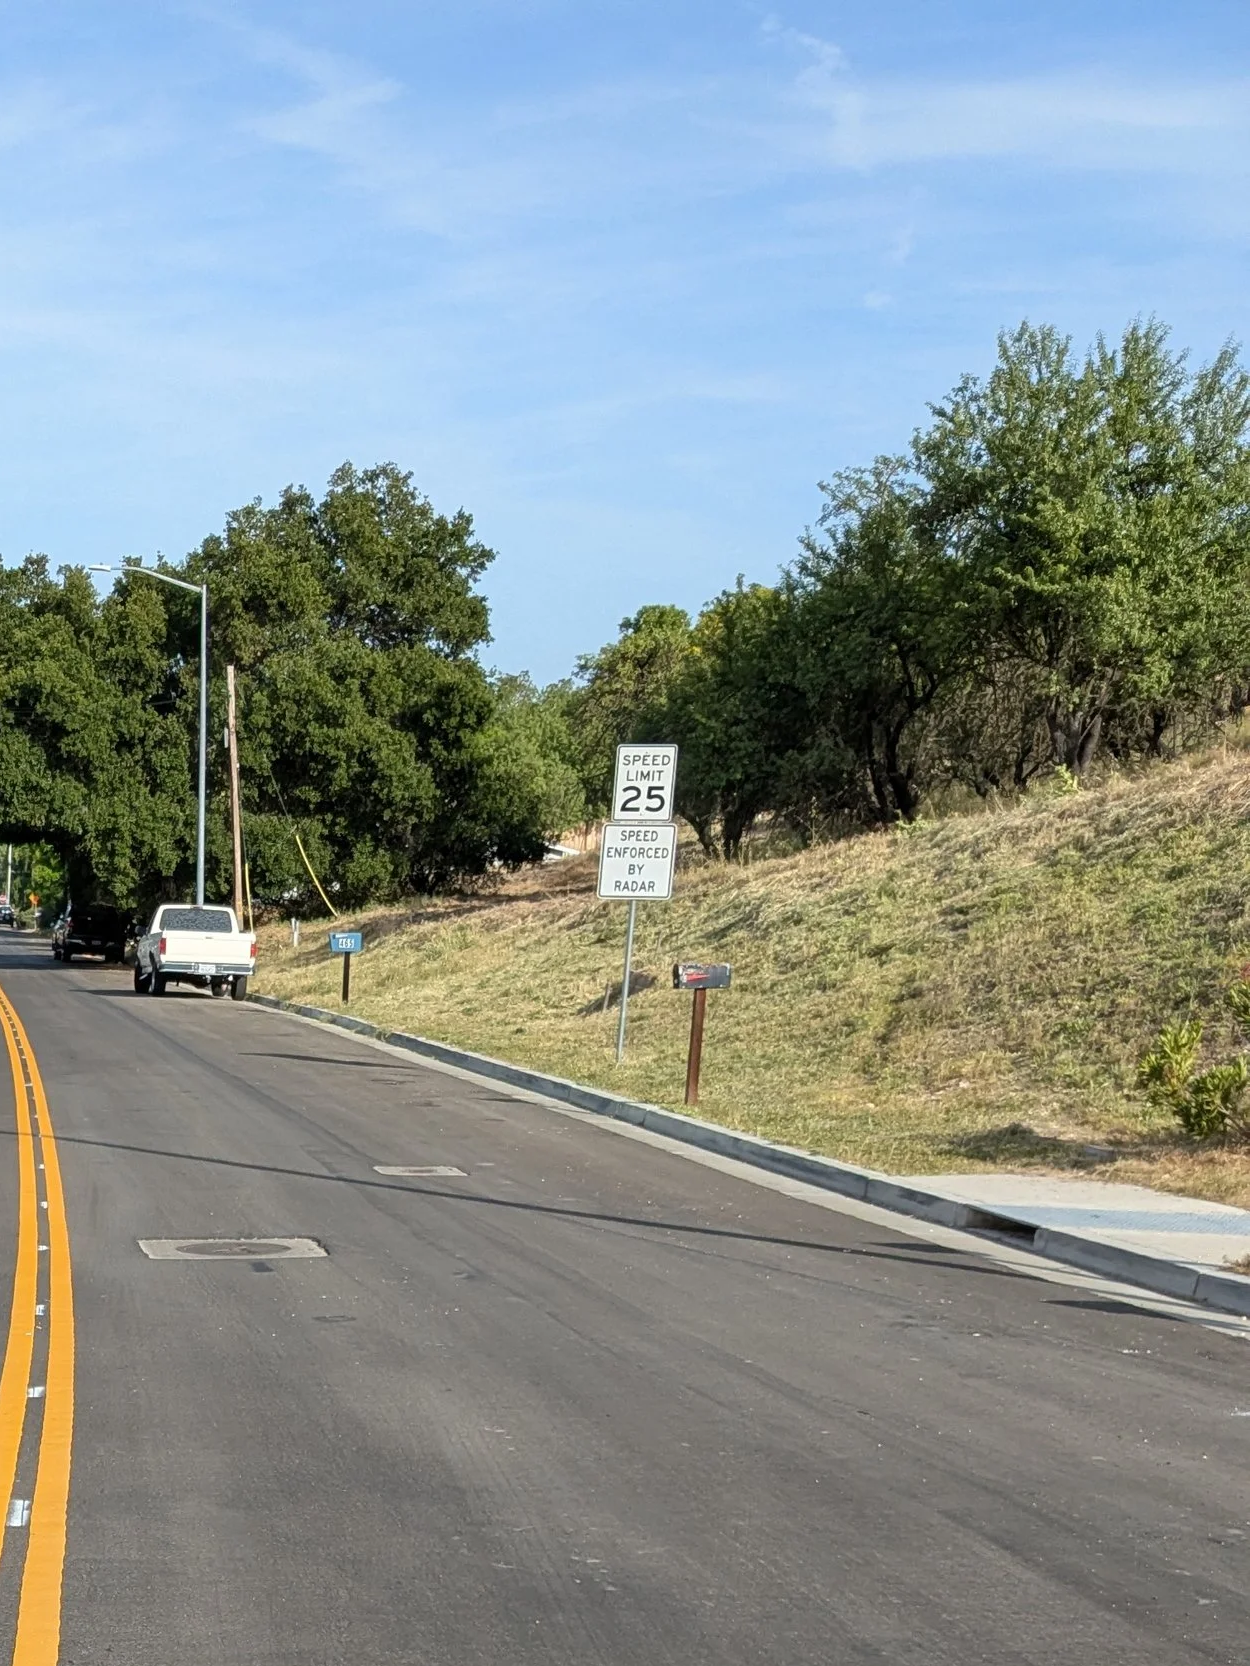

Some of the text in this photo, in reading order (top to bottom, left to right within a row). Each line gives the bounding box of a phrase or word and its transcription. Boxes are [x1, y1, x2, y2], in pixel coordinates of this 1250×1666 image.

[623, 755, 671, 766] SPEED
[626, 770, 664, 782] LIMIT
[620, 786, 665, 812] 25
[620, 830, 658, 842] SPEED
[606, 847, 669, 859] ENFORCED
[628, 864, 645, 875] BY
[614, 881, 656, 892] RADAR
